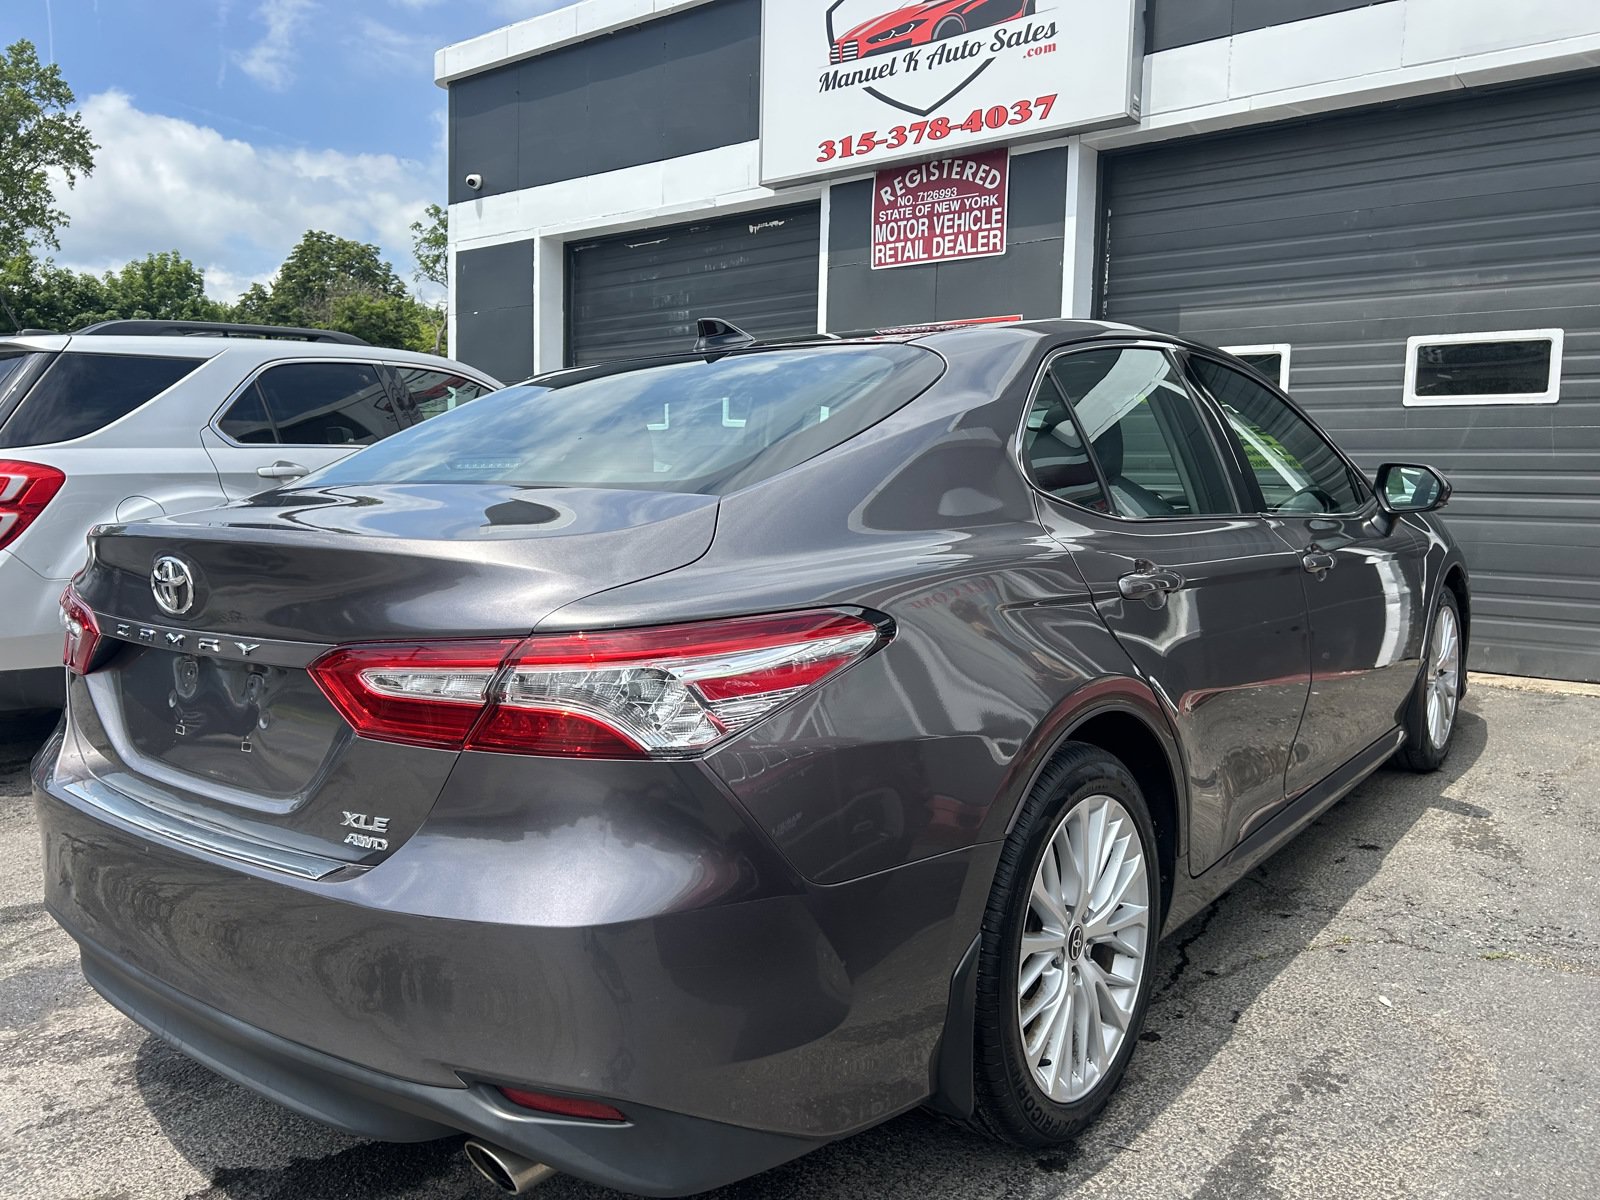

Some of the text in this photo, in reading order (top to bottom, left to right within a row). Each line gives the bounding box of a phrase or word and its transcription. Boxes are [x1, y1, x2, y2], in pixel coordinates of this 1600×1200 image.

[819, 21, 1059, 93] Manuel K Auto Sales
[1022, 43, 1057, 59] .com
[816, 93, 1058, 162] 315-378-4037
[879, 159, 1001, 206] REGISTERED
[897, 187, 957, 207] NO. 7126993
[879, 194, 999, 222] STATE OF NEW YORK
[875, 207, 1002, 243] MOTOR VEHICLE
[875, 230, 1002, 265] RETAIL DEALER
[116, 623, 260, 656] CAMRY
[340, 810, 390, 833] XLE
[343, 833, 389, 851] AWD
